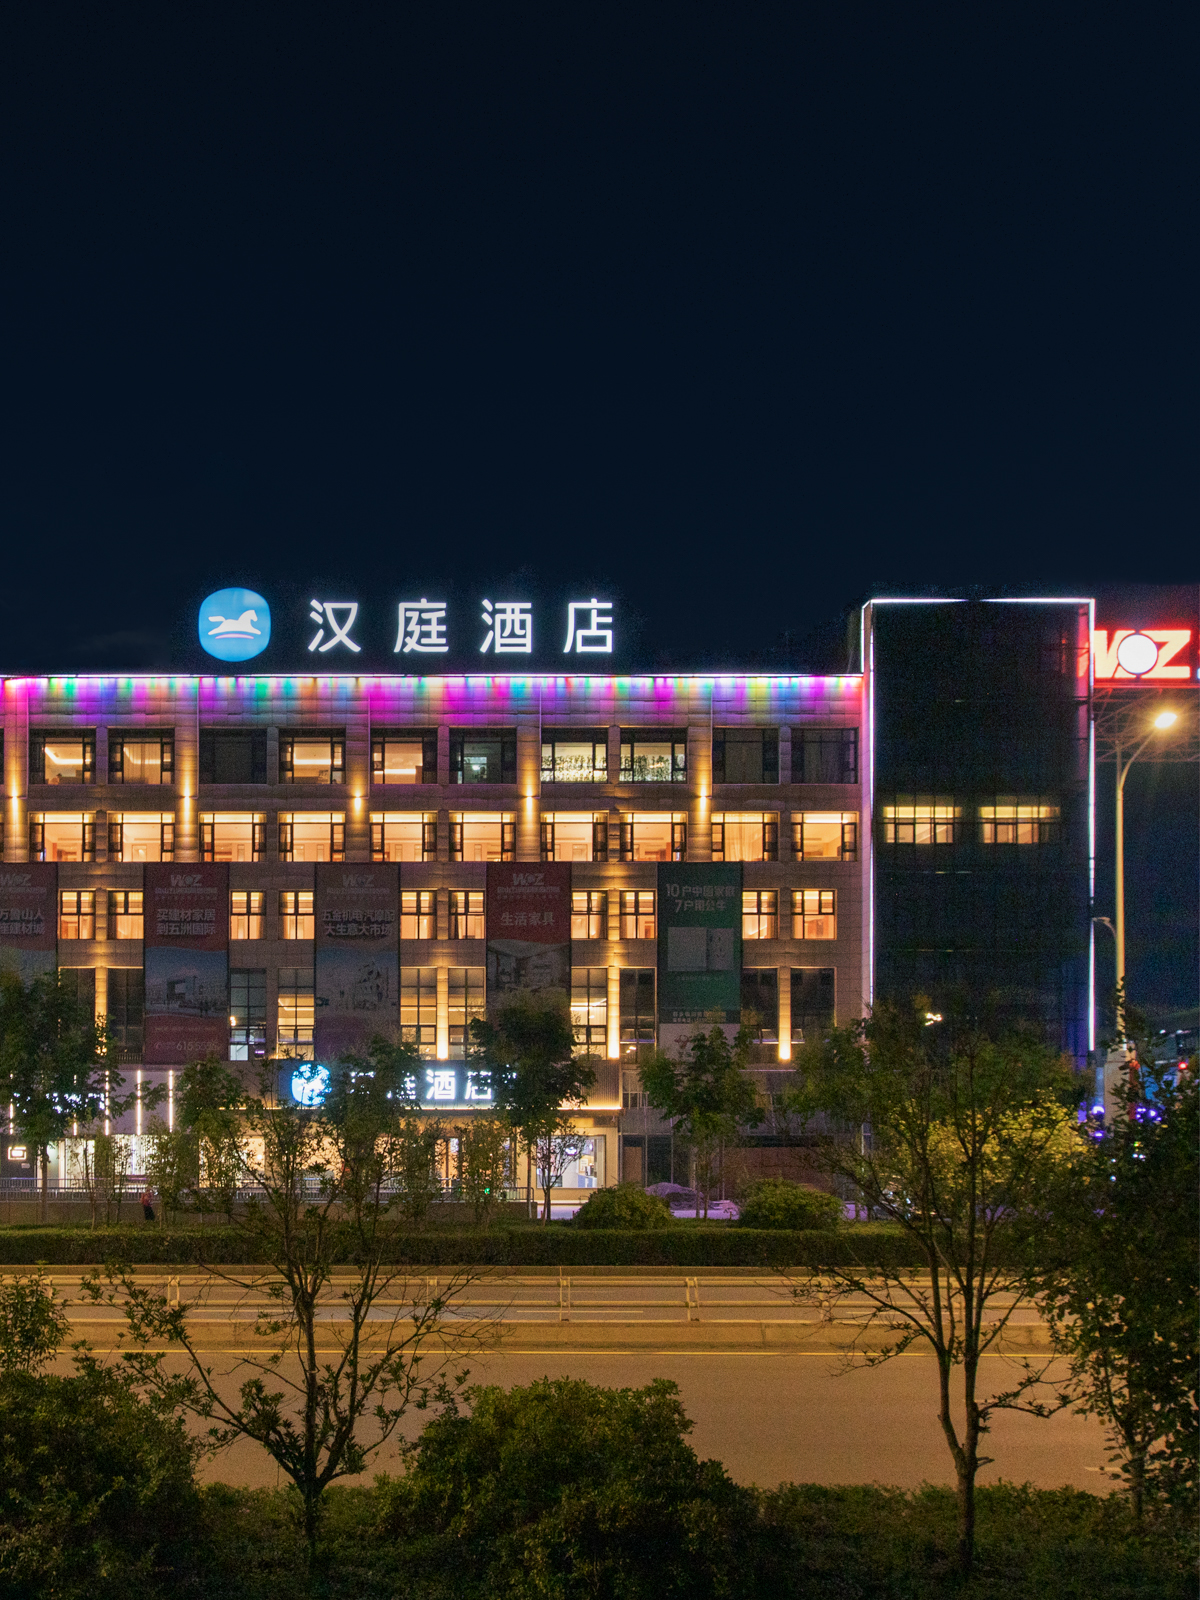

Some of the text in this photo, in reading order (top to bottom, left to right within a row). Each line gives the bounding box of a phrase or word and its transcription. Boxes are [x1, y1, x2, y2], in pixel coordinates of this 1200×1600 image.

[307, 597, 613, 653] 汉庭酒店
[156, 908, 216, 921] 买建材家居
[500, 911, 555, 927] 生活家具
[156, 922, 216, 935] 到五洲国际
[324, 922, 393, 936] 大生意大市场
